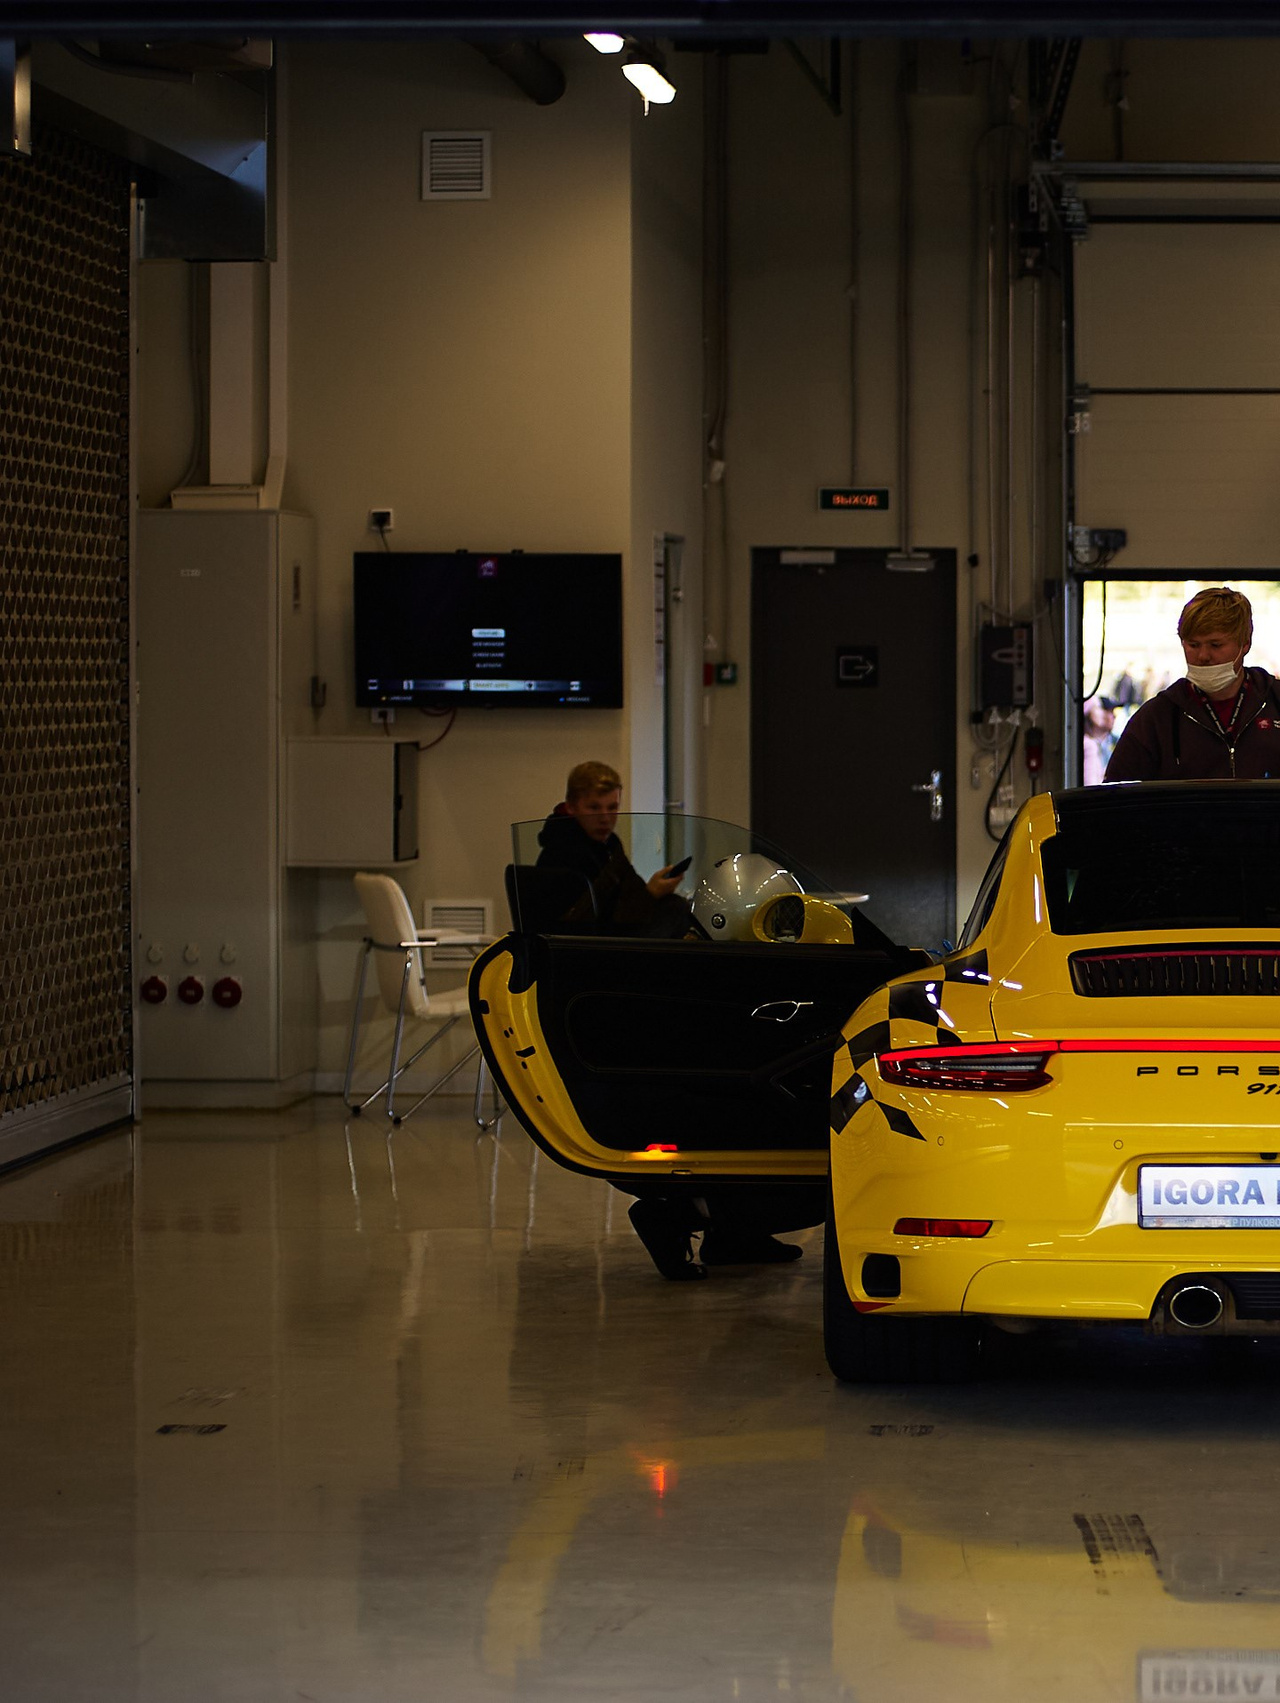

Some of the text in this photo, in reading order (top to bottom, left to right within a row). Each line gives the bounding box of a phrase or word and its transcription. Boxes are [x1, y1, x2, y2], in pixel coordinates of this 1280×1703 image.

[832, 494, 878, 506] ВЫХОД
[1152, 1179, 1265, 1206] IGORA
[1239, 1218, 1280, 1227] ПУЛКОВО
